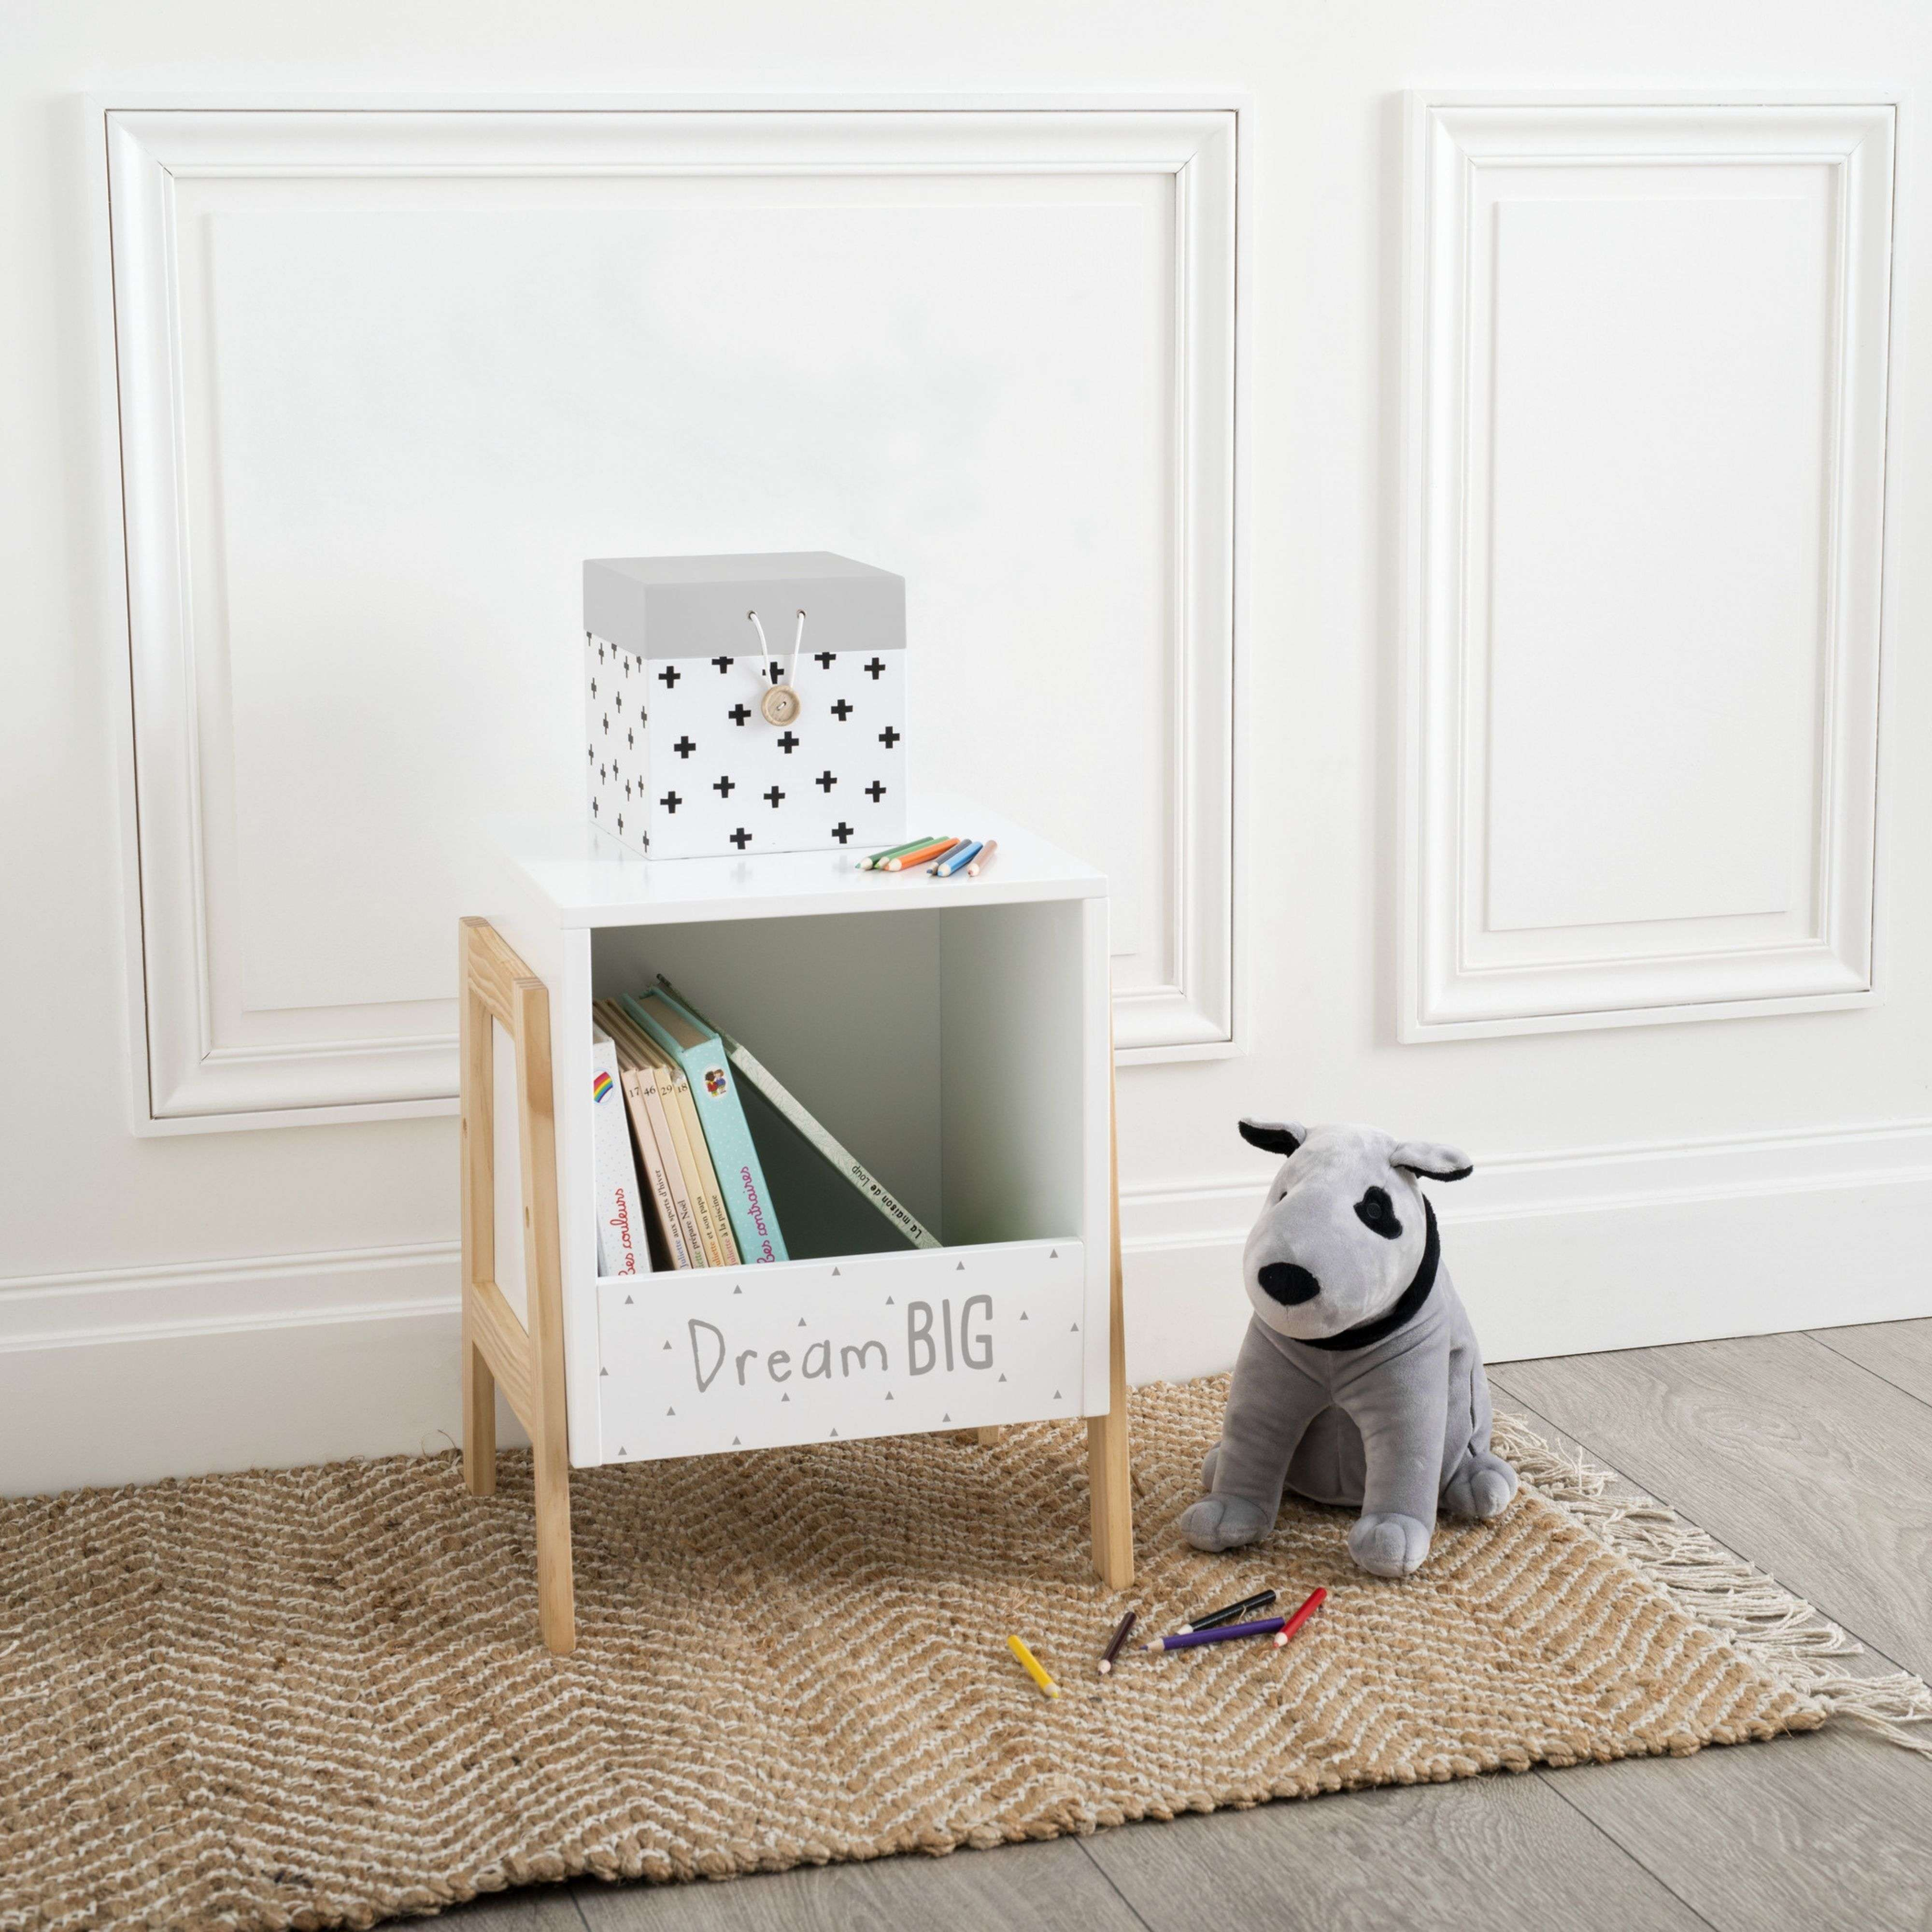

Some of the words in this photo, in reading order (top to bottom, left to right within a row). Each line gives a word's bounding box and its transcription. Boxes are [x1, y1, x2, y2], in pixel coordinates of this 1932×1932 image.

[629, 1087, 639, 1097] 17
[644, 1085, 656, 1096] 46
[661, 1085, 672, 1095] 29
[678, 1083, 688, 1093] 18
[655, 1170, 667, 1196] d'hiver
[852, 1165, 870, 1187] Loup
[870, 1184, 881, 1195] de
[664, 1199, 675, 1222] sports
[697, 1196, 707, 1214] papa
[712, 1195, 725, 1222] piscine
[740, 1166, 768, 1236] contraires
[881, 1195, 910, 1224] maison
[610, 1188, 632, 1249] couleurs
[671, 1223, 679, 1237] aux
[910, 1224, 922, 1239] La
[688, 1318, 888, 1392] Dream
[908, 1294, 993, 1376] BIG
